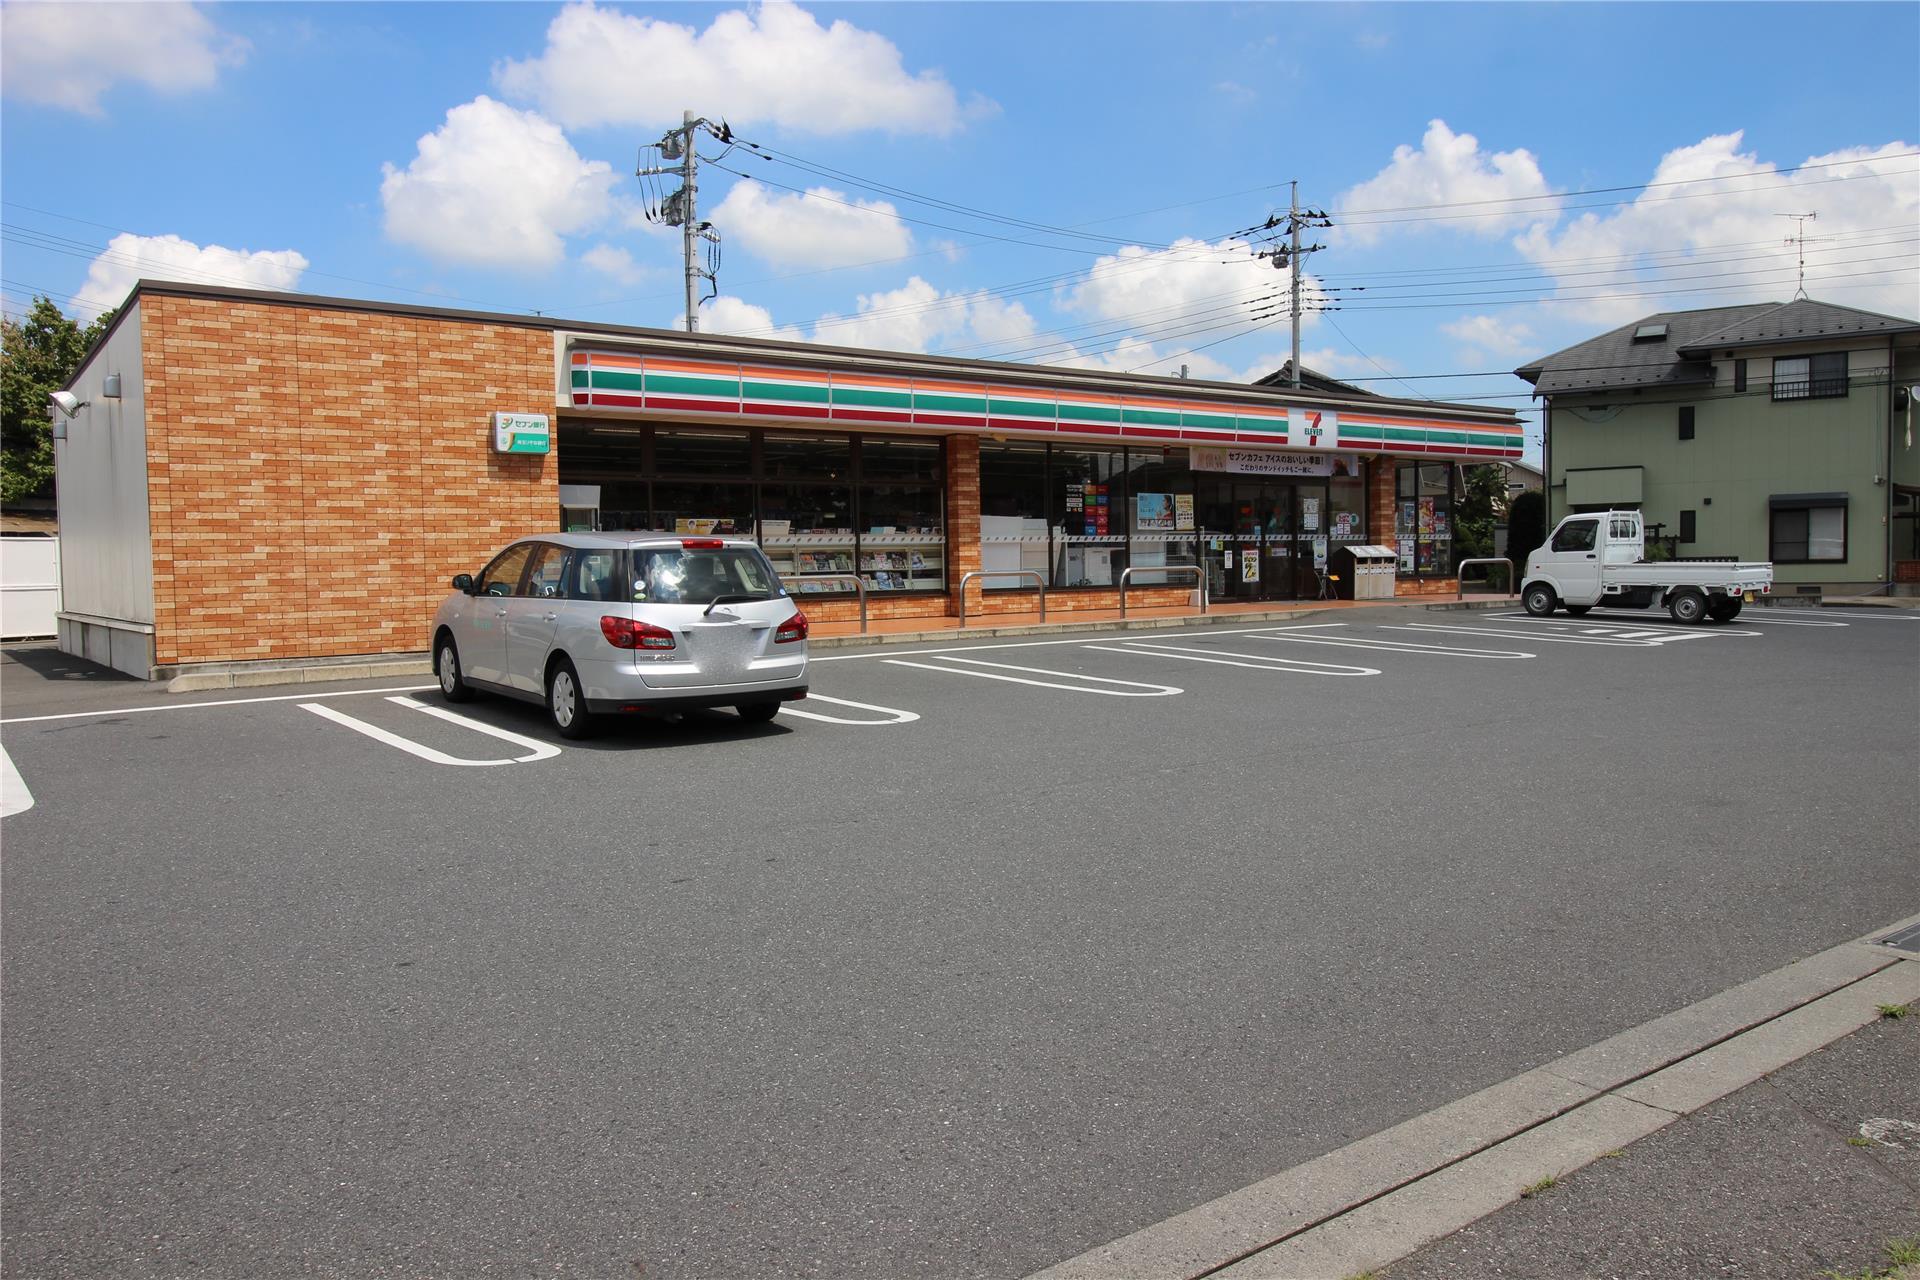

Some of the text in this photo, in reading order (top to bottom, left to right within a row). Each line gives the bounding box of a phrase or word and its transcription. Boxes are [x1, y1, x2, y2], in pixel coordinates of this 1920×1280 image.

[515, 420, 546, 429] セブン銀行
[1304, 410, 1322, 446] 7
[1228, 452, 1263, 462] セブンカフェ
